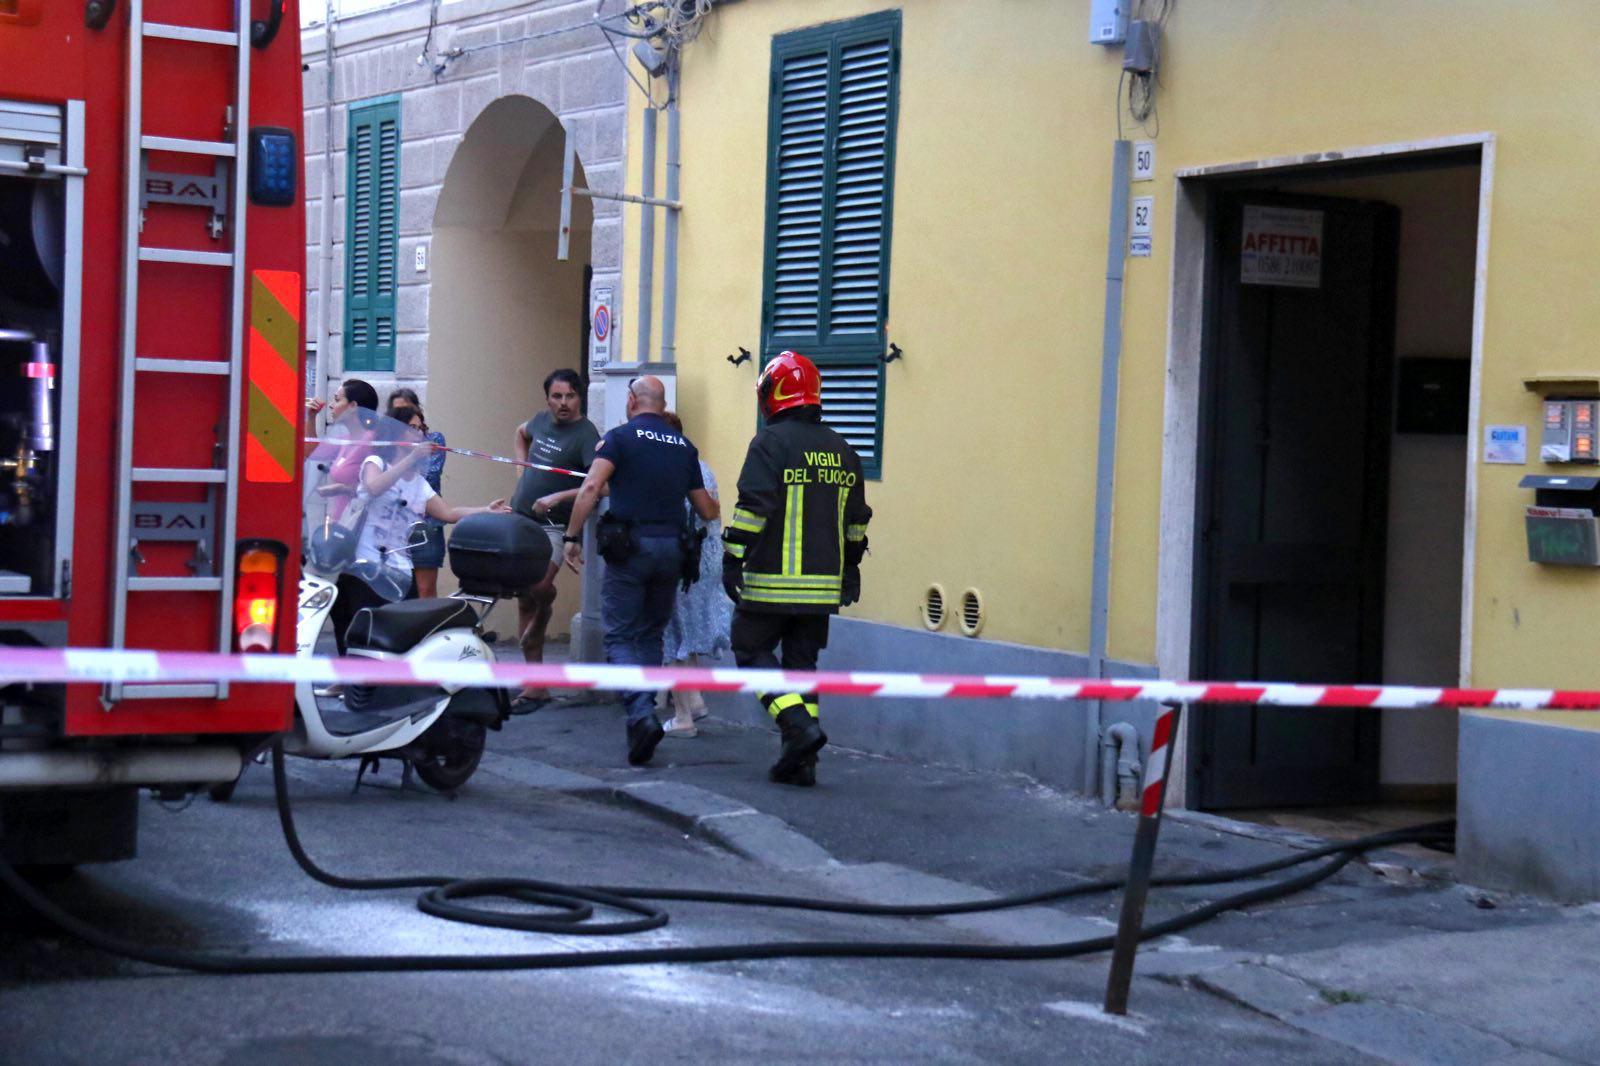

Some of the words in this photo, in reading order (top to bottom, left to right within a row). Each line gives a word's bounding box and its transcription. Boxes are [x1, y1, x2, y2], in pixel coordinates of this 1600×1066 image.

[1137, 150, 1151, 171] 50
[145, 179, 217, 199] BAI
[1135, 206, 1149, 226] 52
[1243, 231, 1320, 257] AFFITTA
[636, 429, 687, 447] POLIZIA
[803, 451, 841, 467] VIGILI
[783, 468, 812, 484] DEL
[817, 468, 856, 487] FUOCO
[134, 514, 206, 529] BAI
